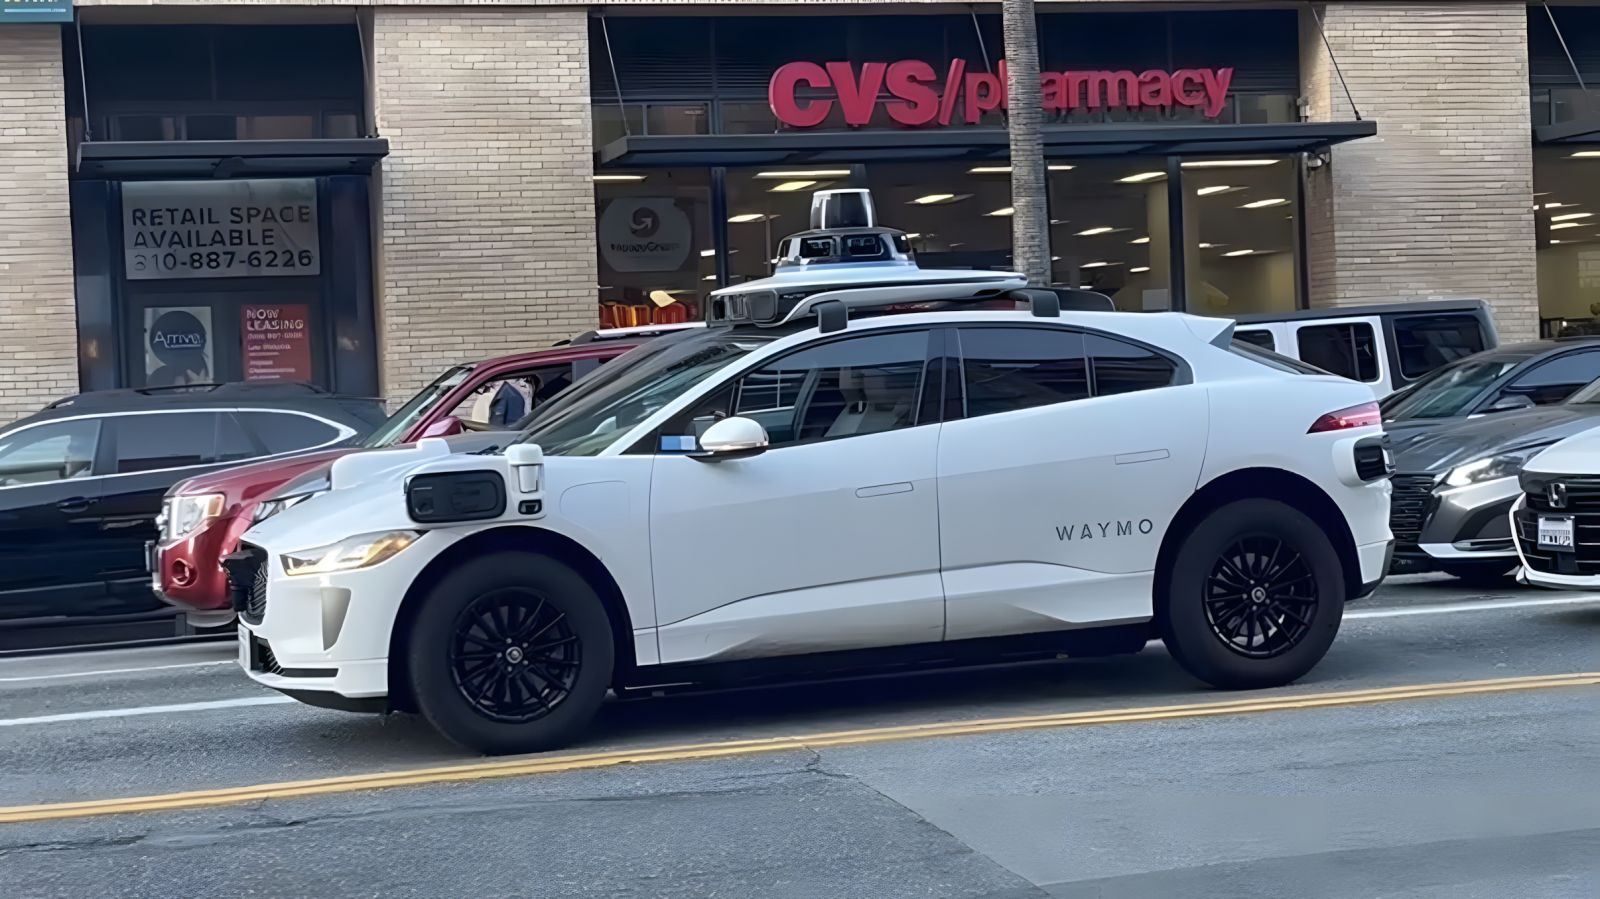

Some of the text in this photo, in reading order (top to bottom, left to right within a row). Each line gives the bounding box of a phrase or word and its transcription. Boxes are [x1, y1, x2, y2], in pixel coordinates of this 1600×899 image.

[132, 205, 311, 226] RETAIL SPACE
[134, 228, 275, 249] AVAILABLE
[134, 249, 313, 272] 310-887-6226
[246, 308, 280, 320] NOW
[246, 319, 304, 331] LEASING
[1055, 518, 1153, 541] WAYMO
